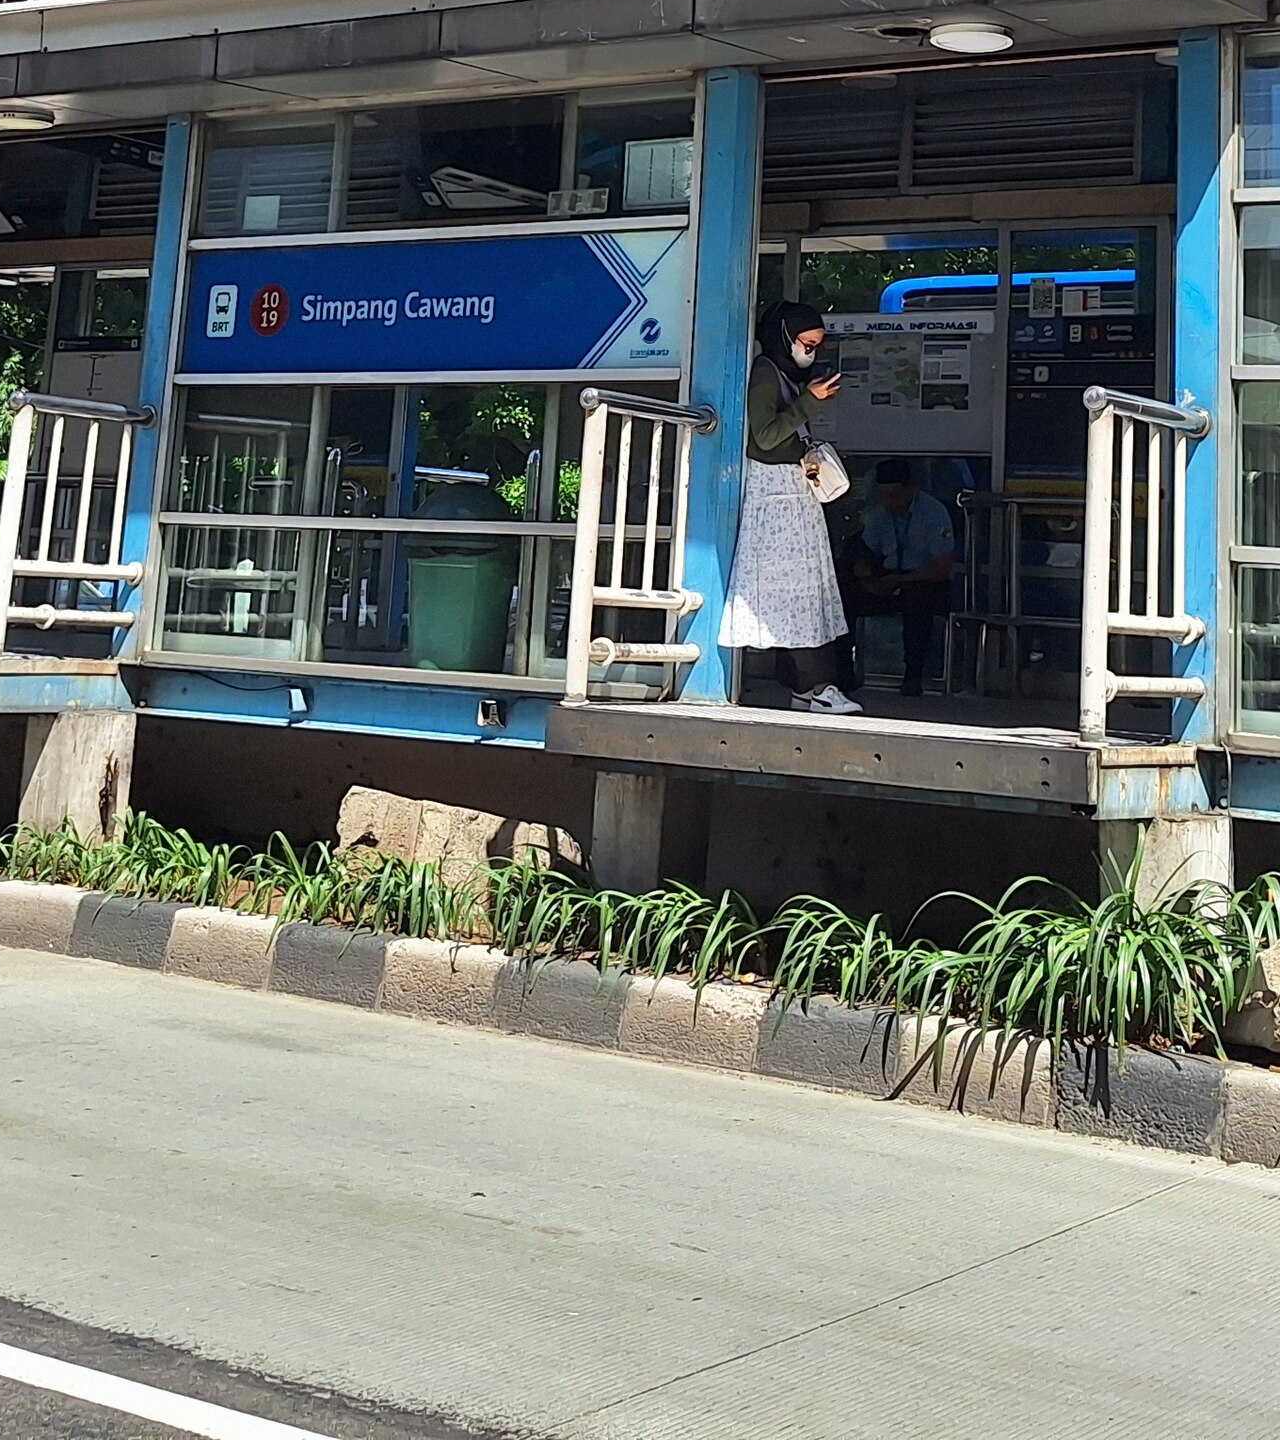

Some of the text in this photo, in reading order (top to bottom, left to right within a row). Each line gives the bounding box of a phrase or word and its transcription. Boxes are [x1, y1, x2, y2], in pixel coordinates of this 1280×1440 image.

[261, 291, 280, 309] 10
[301, 291, 496, 327] Simpang Cawang
[211, 320, 230, 333] BRT
[260, 310, 279, 328] 19
[866, 321, 978, 331] MEDIA INFORMASI
